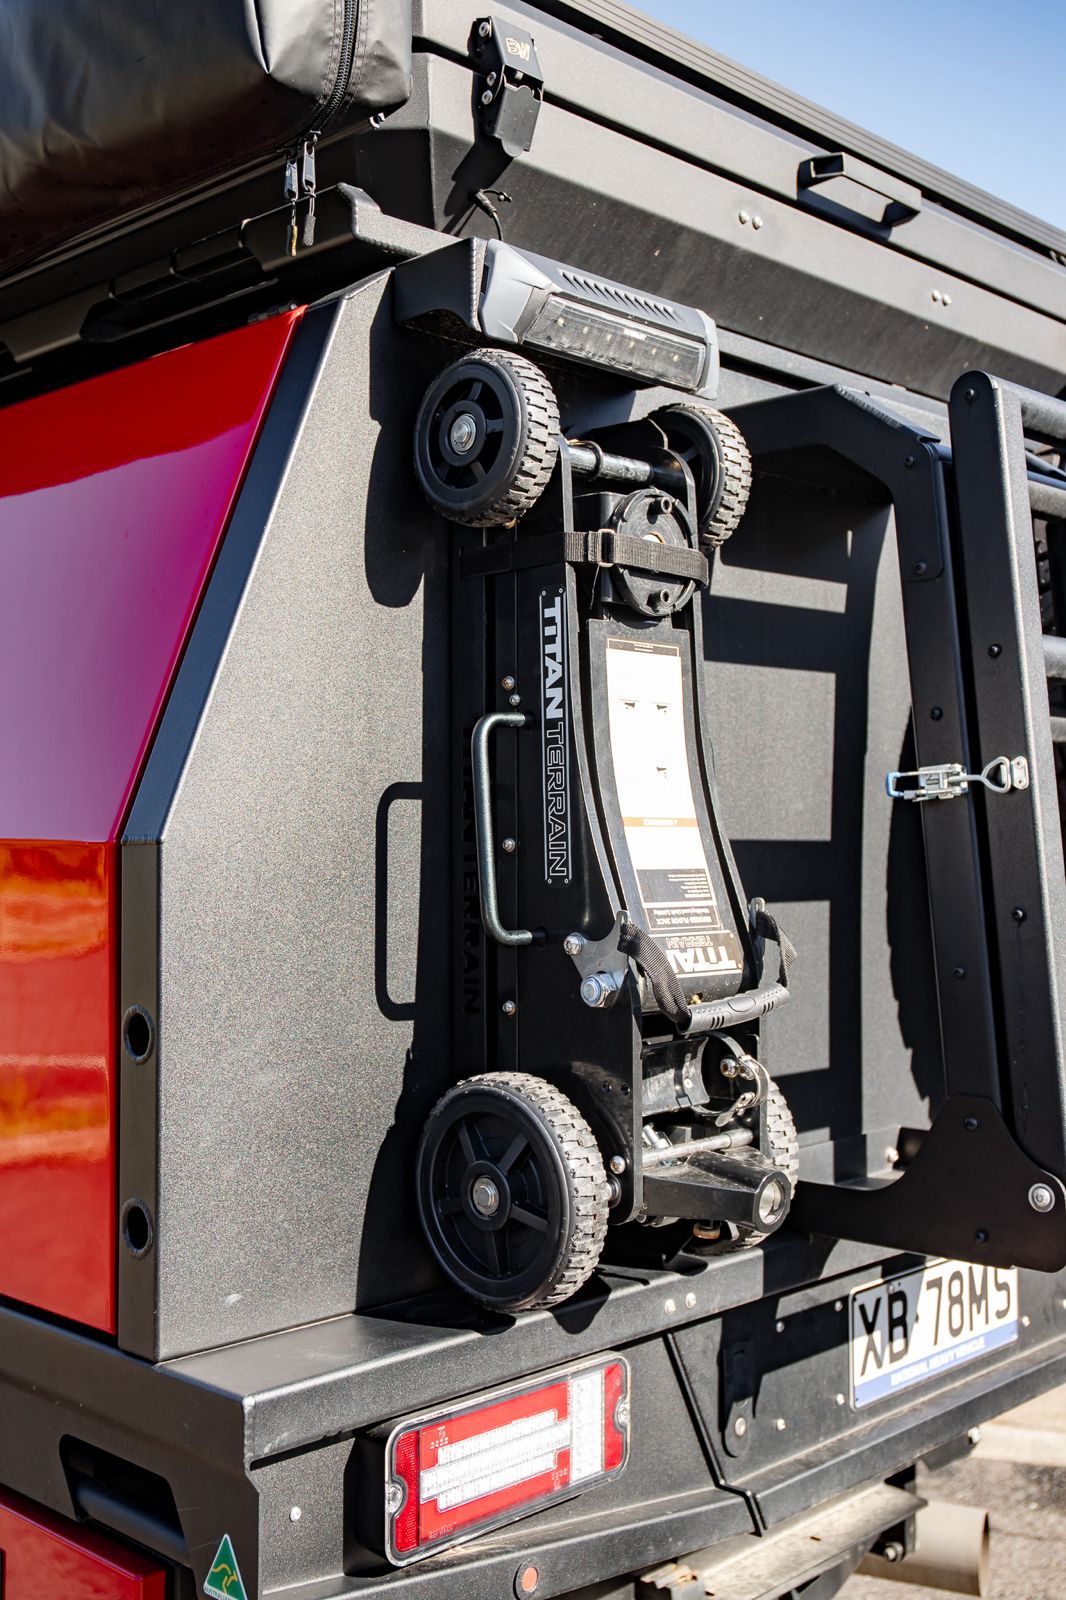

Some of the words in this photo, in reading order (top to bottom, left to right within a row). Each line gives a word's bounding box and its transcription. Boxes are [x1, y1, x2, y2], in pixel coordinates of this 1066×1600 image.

[544, 596, 564, 719] TITAN
[547, 721, 567, 876] TERRAIN
[665, 935, 713, 949] TERRAIN
[926, 1265, 1011, 1346] 78MS
